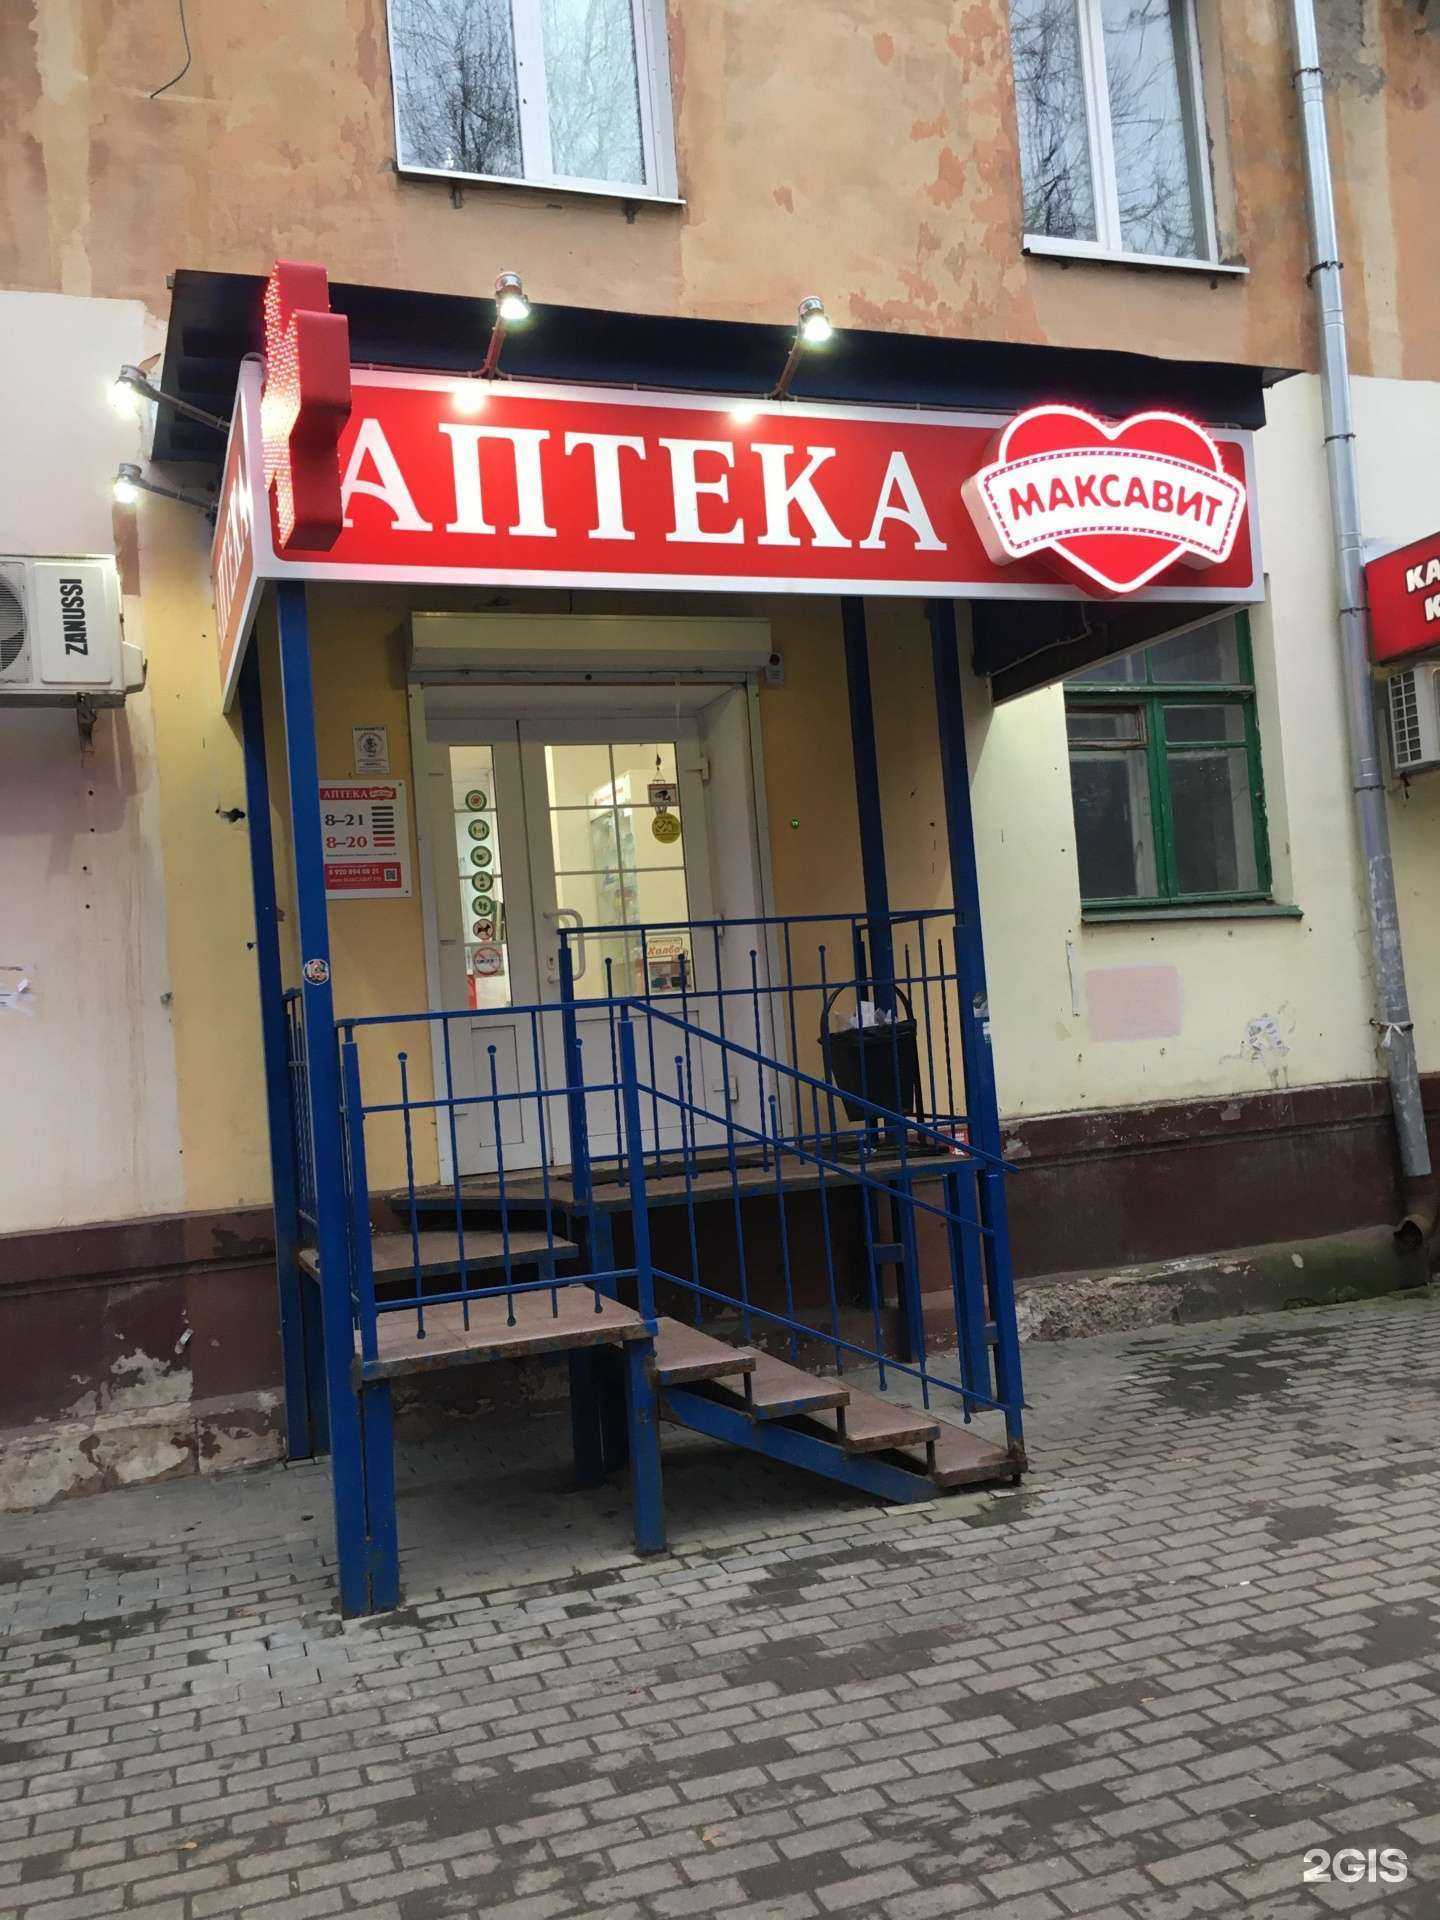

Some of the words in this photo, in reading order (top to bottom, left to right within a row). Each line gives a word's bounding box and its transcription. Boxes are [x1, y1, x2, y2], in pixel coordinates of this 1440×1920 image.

[341, 418, 948, 552] АПТЕКА
[1008, 473, 1223, 527] МАКСАВИТ
[59, 578, 89, 656] ZANUSSI
[323, 789, 368, 799] АПТЕКА
